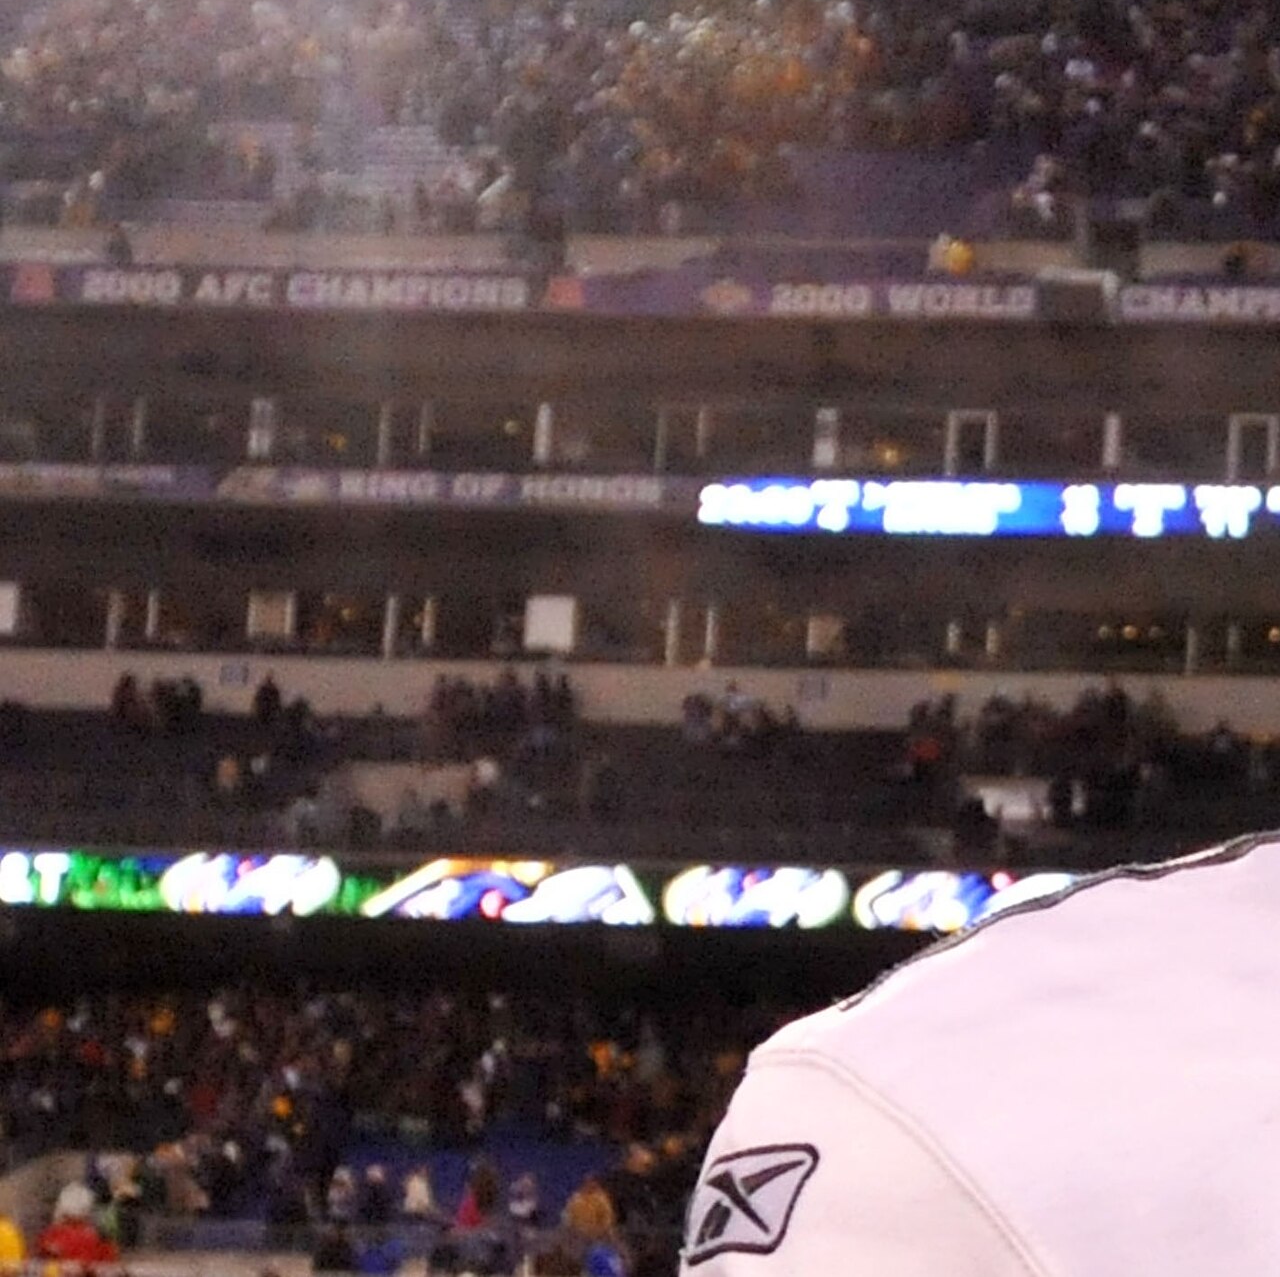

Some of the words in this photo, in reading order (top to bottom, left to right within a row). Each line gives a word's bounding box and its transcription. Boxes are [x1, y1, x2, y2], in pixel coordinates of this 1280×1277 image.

[196, 272, 272, 305] AFC
[287, 273, 527, 309] CHAMPIONS
[889, 285, 1034, 314] WORLD
